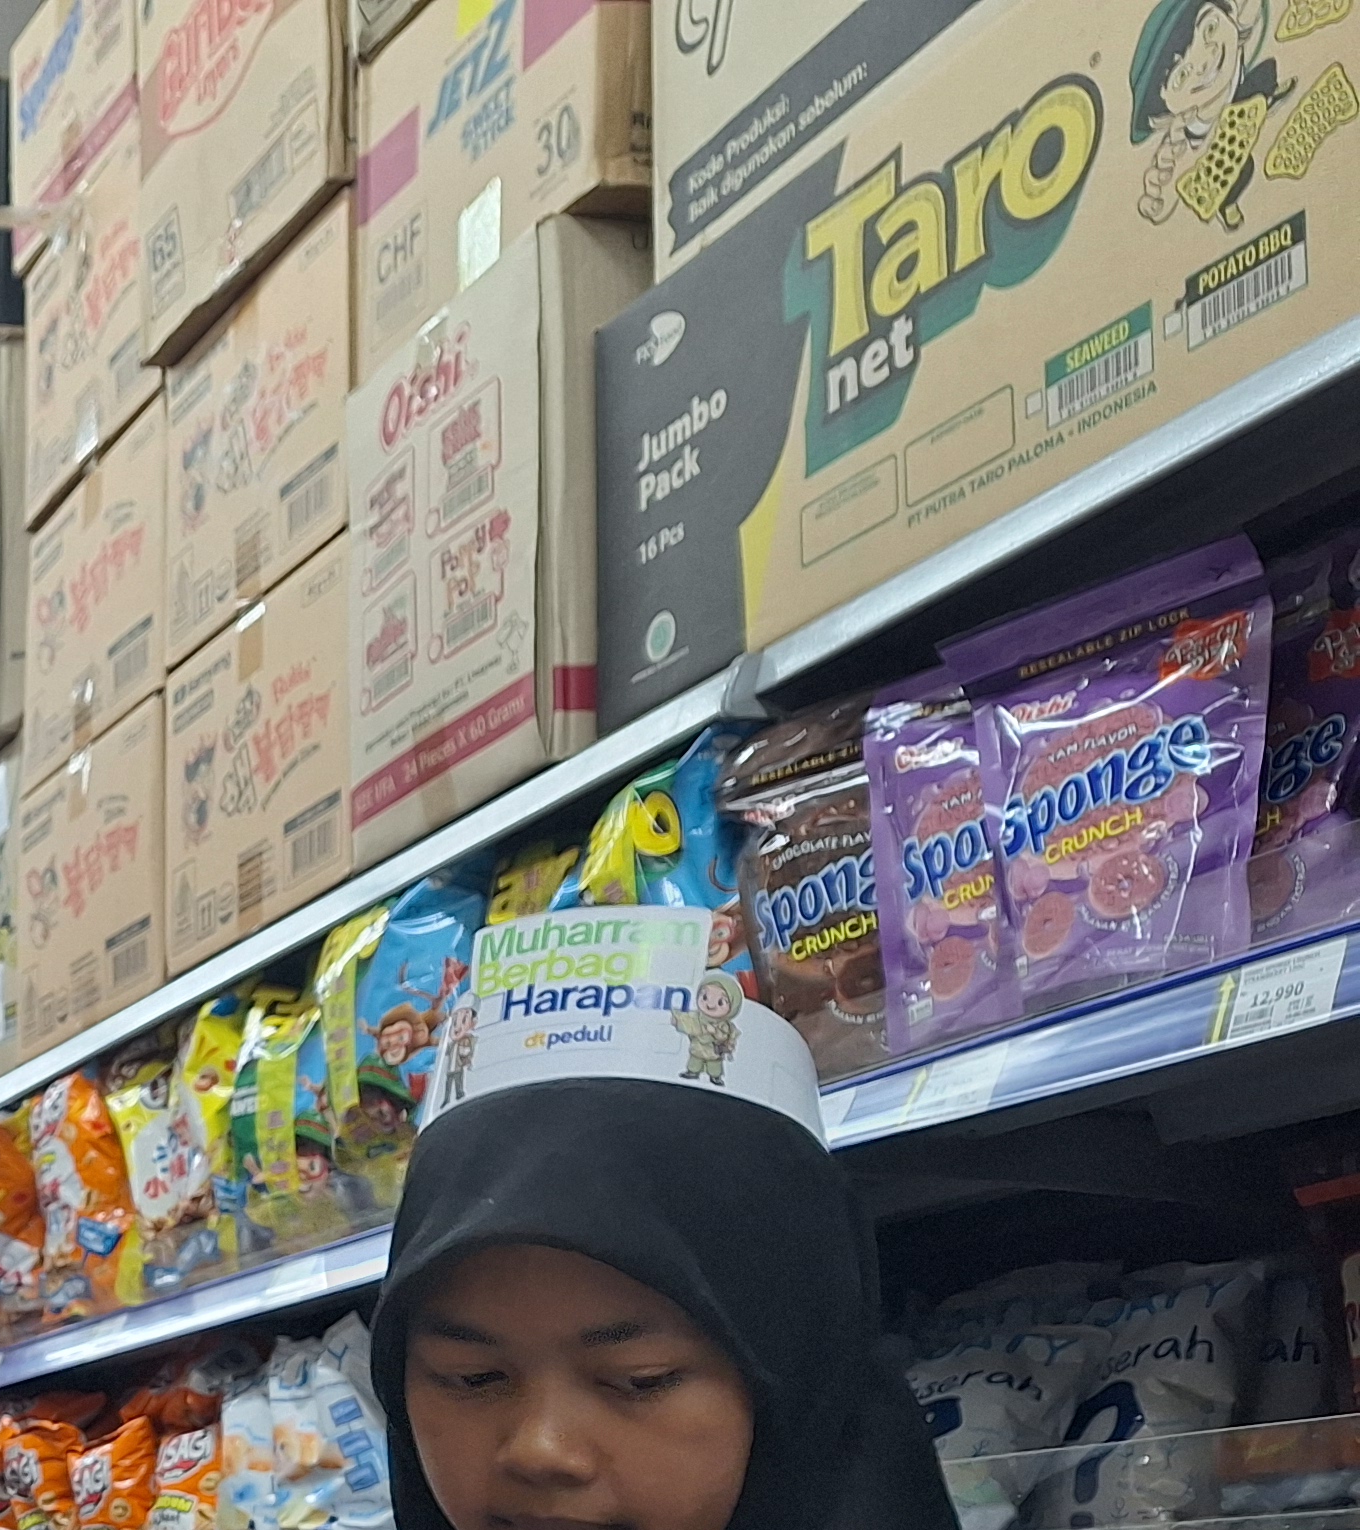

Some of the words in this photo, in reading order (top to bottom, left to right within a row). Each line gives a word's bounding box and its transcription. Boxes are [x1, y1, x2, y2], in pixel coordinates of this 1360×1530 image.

[805, 78, 1102, 358] Taro
[1197, 241, 1251, 296] POTATO
[1254, 226, 1293, 264] BBQ
[826, 313, 915, 416] net
[1064, 320, 1130, 374] SEAWEED
[381, 321, 470, 455] Oishi
[637, 388, 728, 473] Jumbo
[925, 488, 967, 519] PUTRA
[969, 465, 1005, 493] TARO
[1008, 431, 1066, 473] PALOMA
[1078, 380, 1158, 434] INDONESIA
[638, 447, 701, 512] Pack
[639, 536, 658, 565] 16
[659, 520, 685, 556] Pcs
[831, 828, 872, 851] FLAV
[1044, 806, 1144, 865] CRUNCH
[942, 874, 995, 912] CRUN
[481, 915, 700, 963] Muharram
[792, 914, 878, 962] CRUNCH
[478, 948, 652, 995] Berbagi
[1251, 980, 1305, 1008] 12,990
[504, 982, 691, 1022] Harapan
